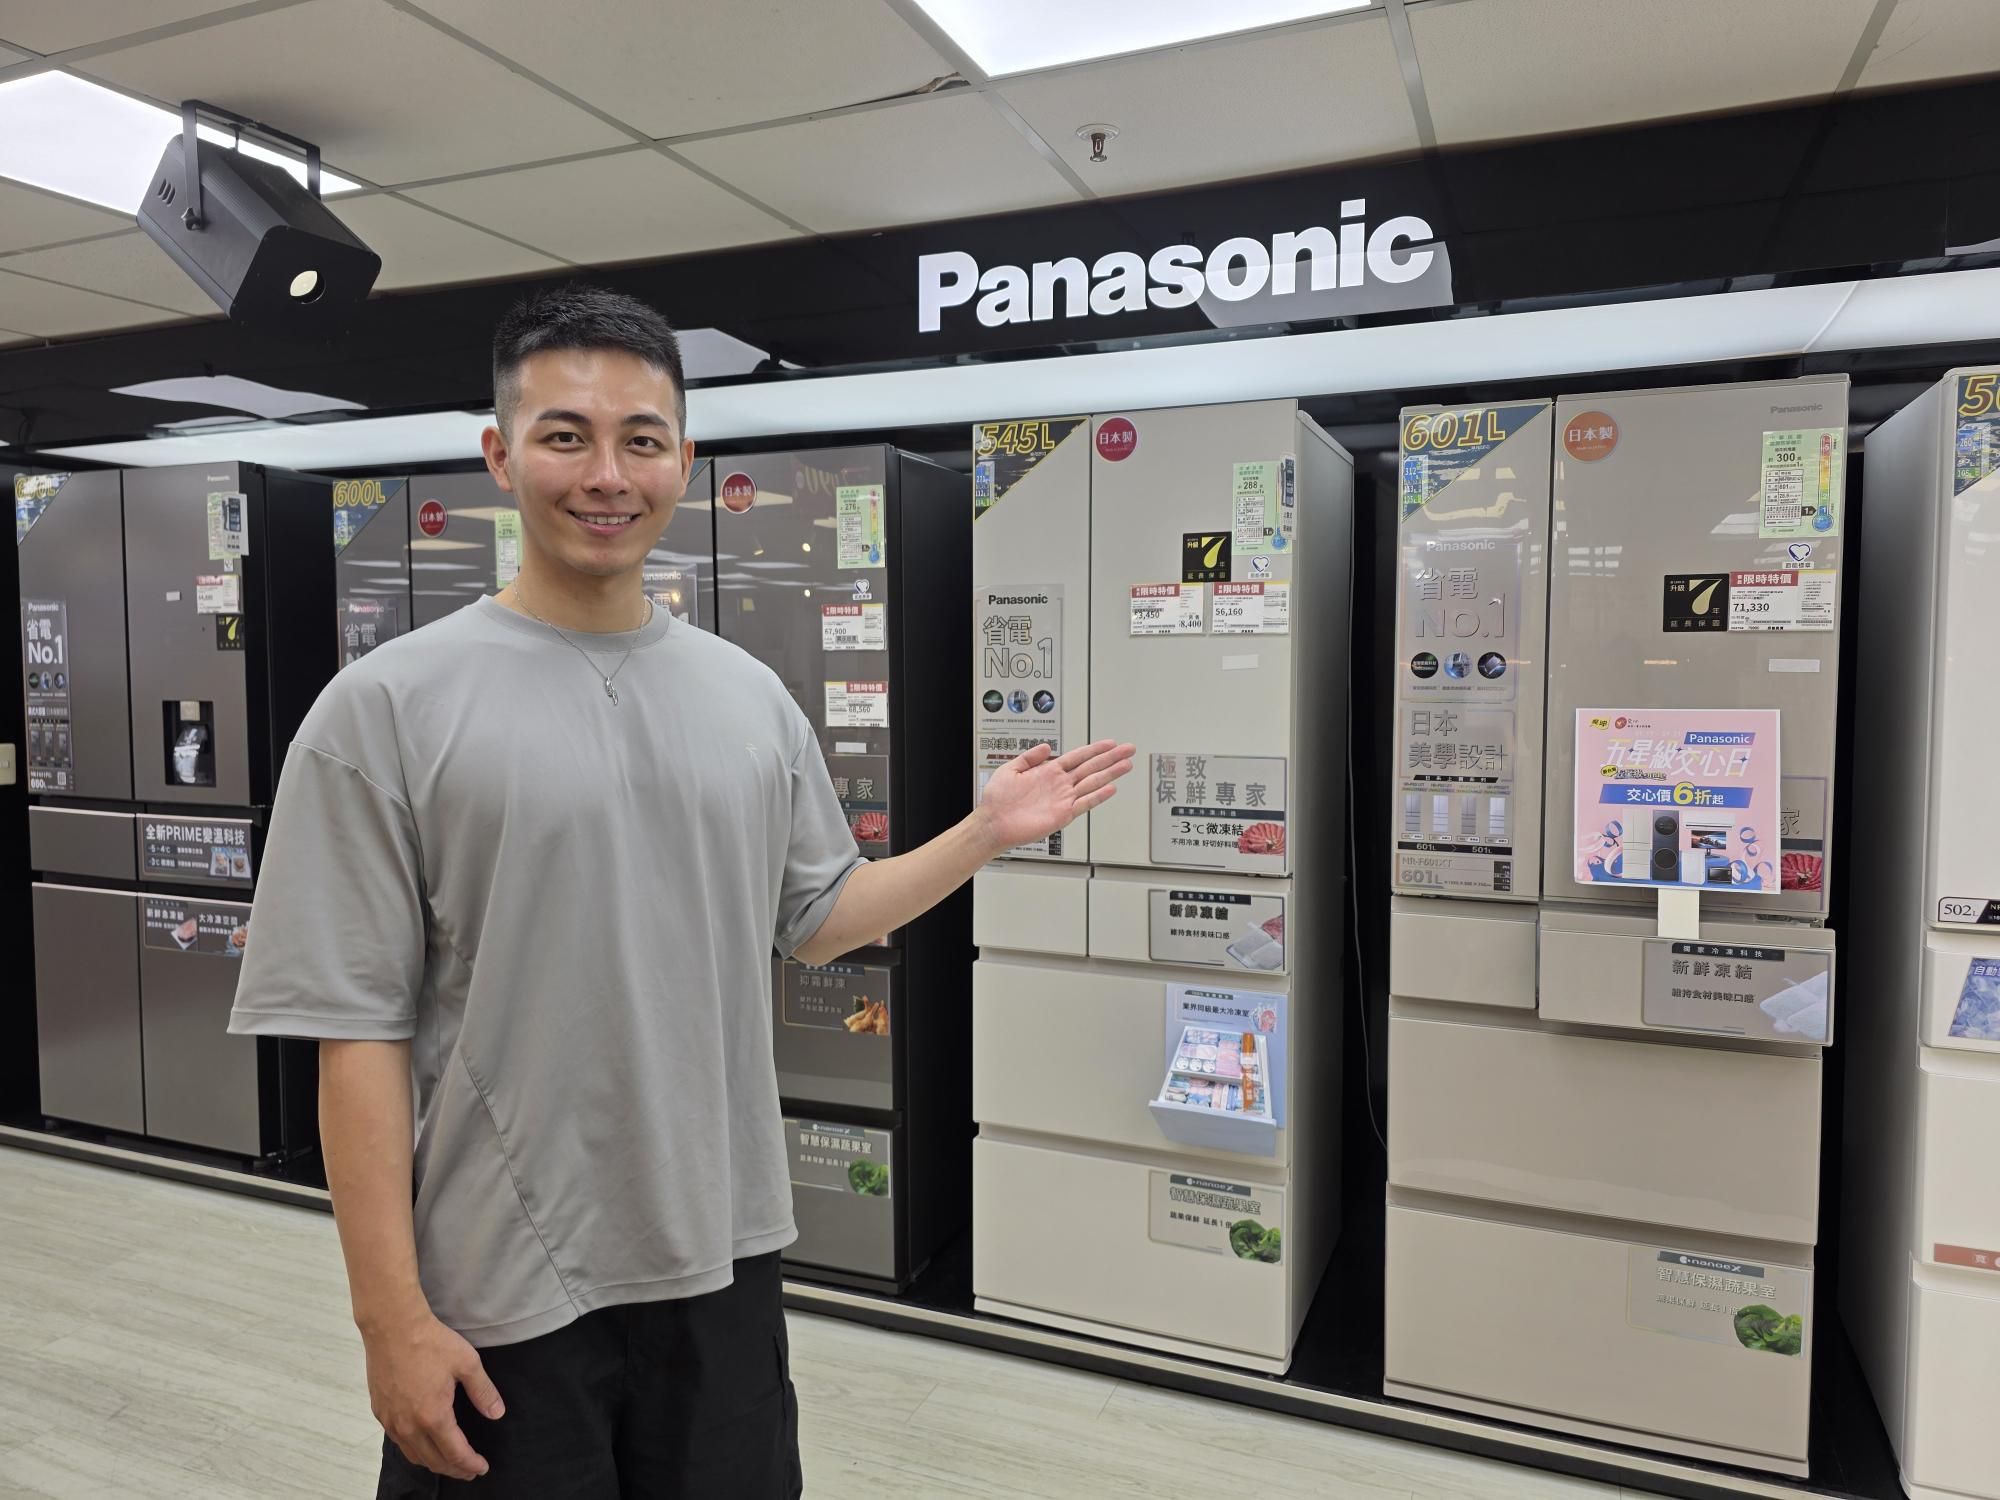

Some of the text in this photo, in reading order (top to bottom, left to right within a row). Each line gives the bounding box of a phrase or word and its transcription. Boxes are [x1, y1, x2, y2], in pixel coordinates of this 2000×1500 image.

[918, 198, 1434, 332] Panasonic
[1770, 403, 1823, 414] Panasonic
[1099, 431, 1133, 445] 日本製
[1403, 410, 1505, 450] 601L
[1569, 426, 1613, 442] 日本製
[978, 422, 1055, 456] 545L
[1776, 453, 1796, 462] 300
[335, 480, 386, 508] 600L
[725, 486, 752, 497] 日本製
[421, 512, 443, 523] 日本製
[1427, 540, 1495, 552] Panasonic
[642, 570, 681, 581] anasonic
[1416, 567, 1478, 600] 省電
[1743, 573, 1792, 584] 限時特價
[1223, 584, 1260, 594] 限時特價
[1689, 578, 1722, 615] 7
[28, 603, 59, 612] Panasonic
[989, 594, 1048, 605] Panasonic
[349, 604, 384, 615] Panasonic
[1215, 608, 1244, 617] 56,160
[1415, 593, 1506, 638] No.1
[1733, 603, 1770, 613] 71,330
[27, 619, 51, 640] 省電
[345, 624, 376, 647] 省電
[825, 628, 847, 637] 67,900
[983, 616, 1032, 645] 省電
[28, 634, 63, 664] No.1
[985, 637, 1053, 678] No.1
[1411, 710, 1457, 737] 日本
[980, 737, 1017, 750] 日本美學
[1690, 734, 1750, 745] Panasonic
[1408, 742, 1509, 771] 美學設計
[1600, 737, 1752, 779] 五星級交心日
[1156, 755, 1206, 780] 極致
[1156, 780, 1266, 807] 保鮮專家
[1627, 781, 1724, 805] 交心價6折起
[145, 823, 245, 845] 全新PRIME變溫科技
[1171, 837, 1199, 846] 不用冷凍
[1416, 842, 1493, 854] 601L 501L
[1401, 869, 1443, 885] 601L
[1171, 928, 1230, 940] 維持食材美味口感
[1671, 959, 1752, 981] 新鮮凍結
[1974, 965, 2000, 977] 自動
[1672, 988, 1754, 1004] 維持食材美味口感
[1183, 1002, 1250, 1017] 業界同級最大冷凍室
[800, 1132, 872, 1155] 智慧保濕蔬果室
[1170, 1186, 1261, 1216] 智慧保濕蔬果室
[1170, 1211, 1200, 1223] 蔬果保鮮
[1657, 1266, 1776, 1300] 智慧保濕蔬果室
